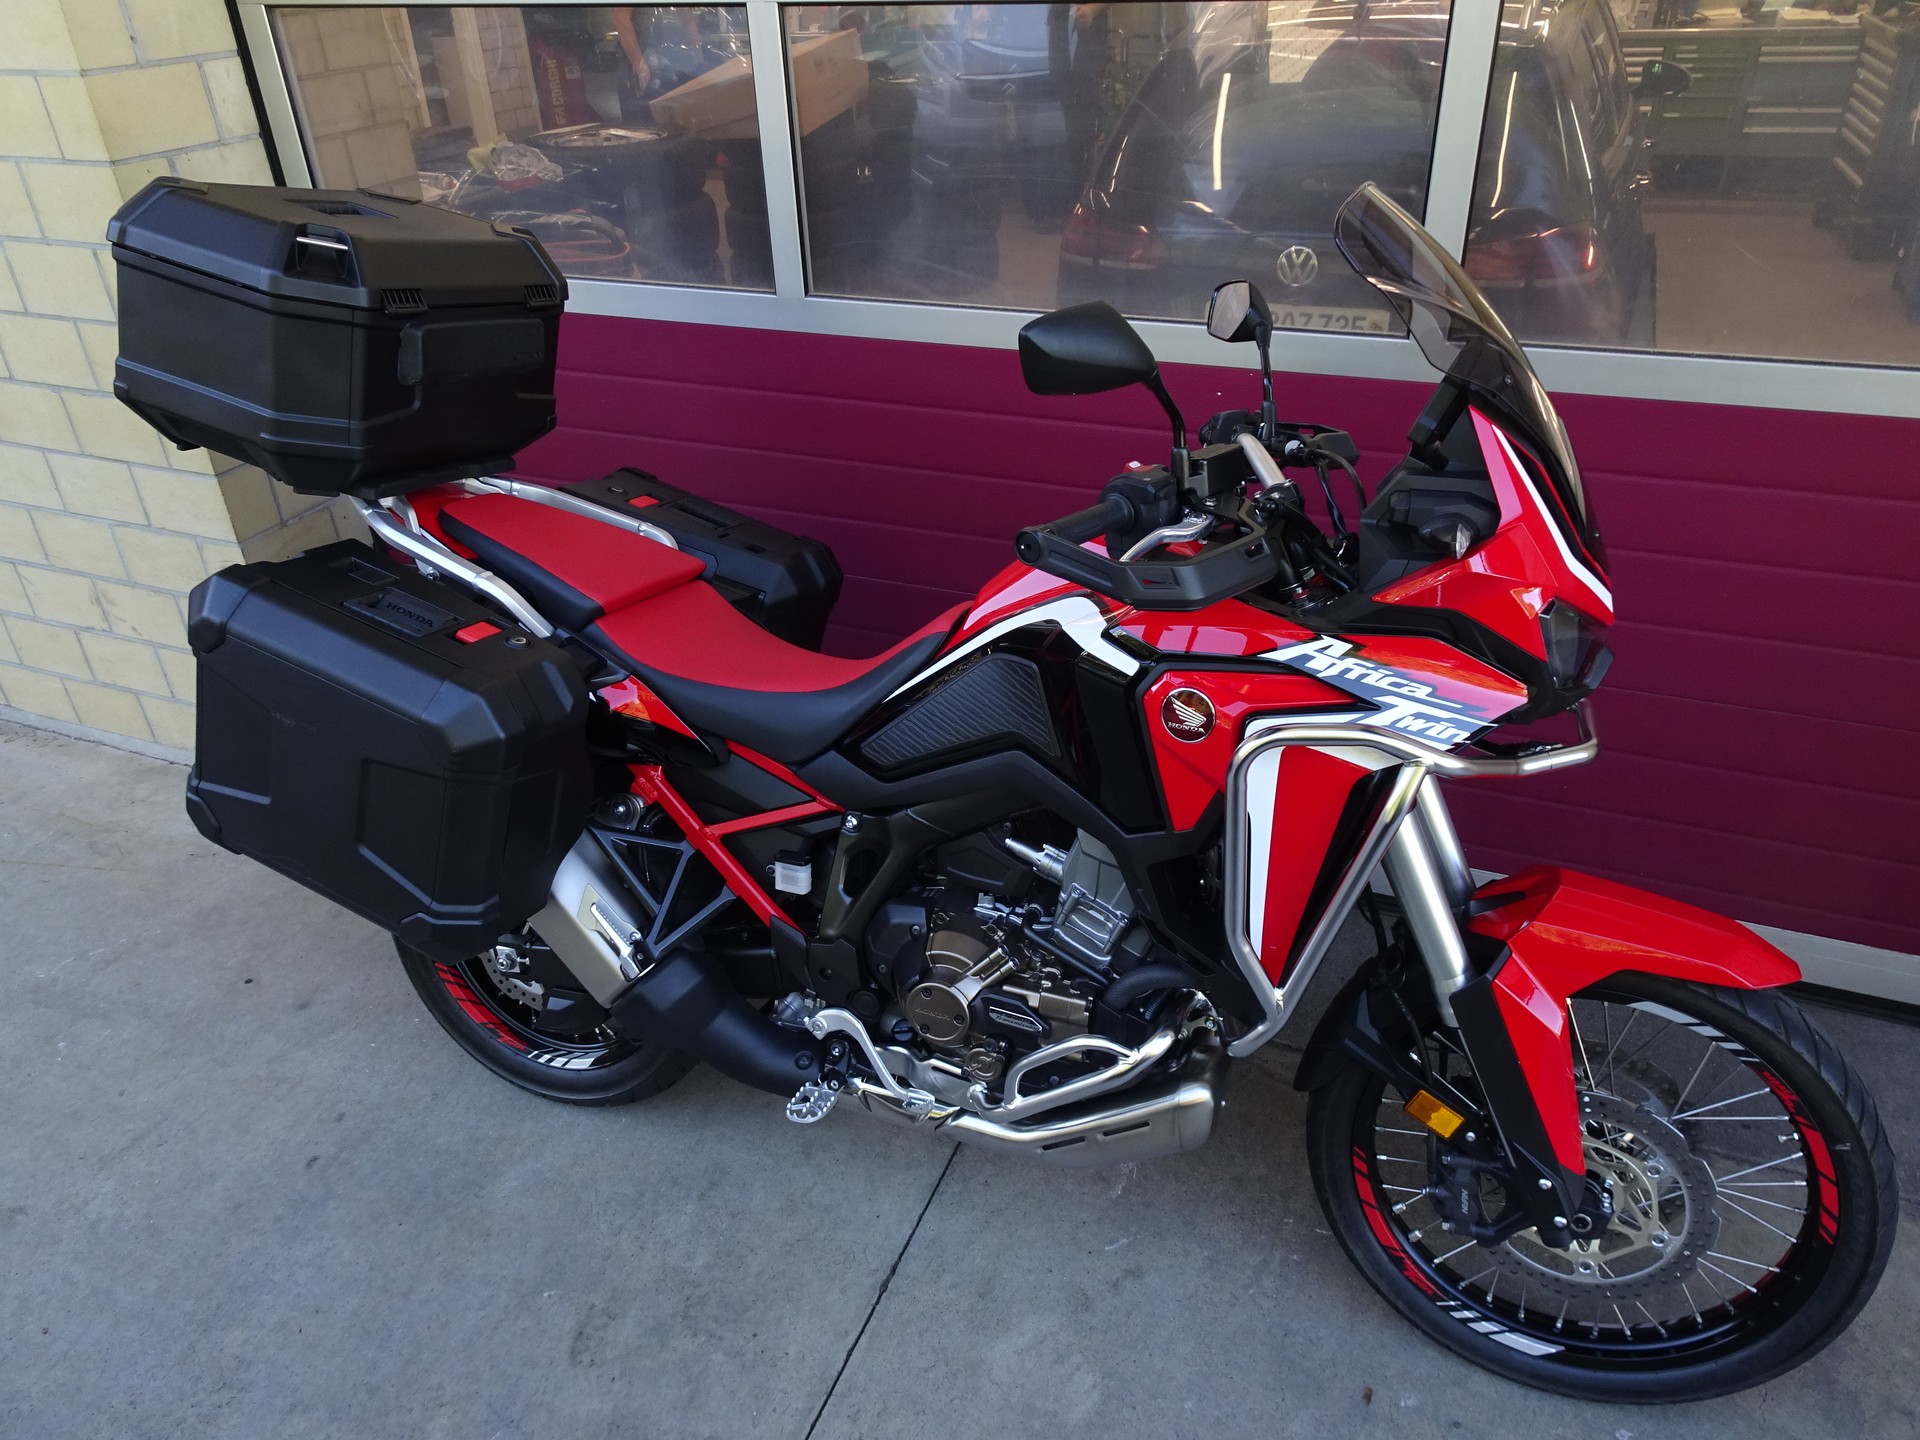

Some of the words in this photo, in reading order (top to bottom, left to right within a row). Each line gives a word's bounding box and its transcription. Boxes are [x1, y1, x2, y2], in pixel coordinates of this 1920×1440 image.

[386, 602, 433, 627] HONDA
[1257, 634, 1463, 708] Africa
[1167, 721, 1205, 734] HONDA
[1356, 695, 1498, 745] Twin
